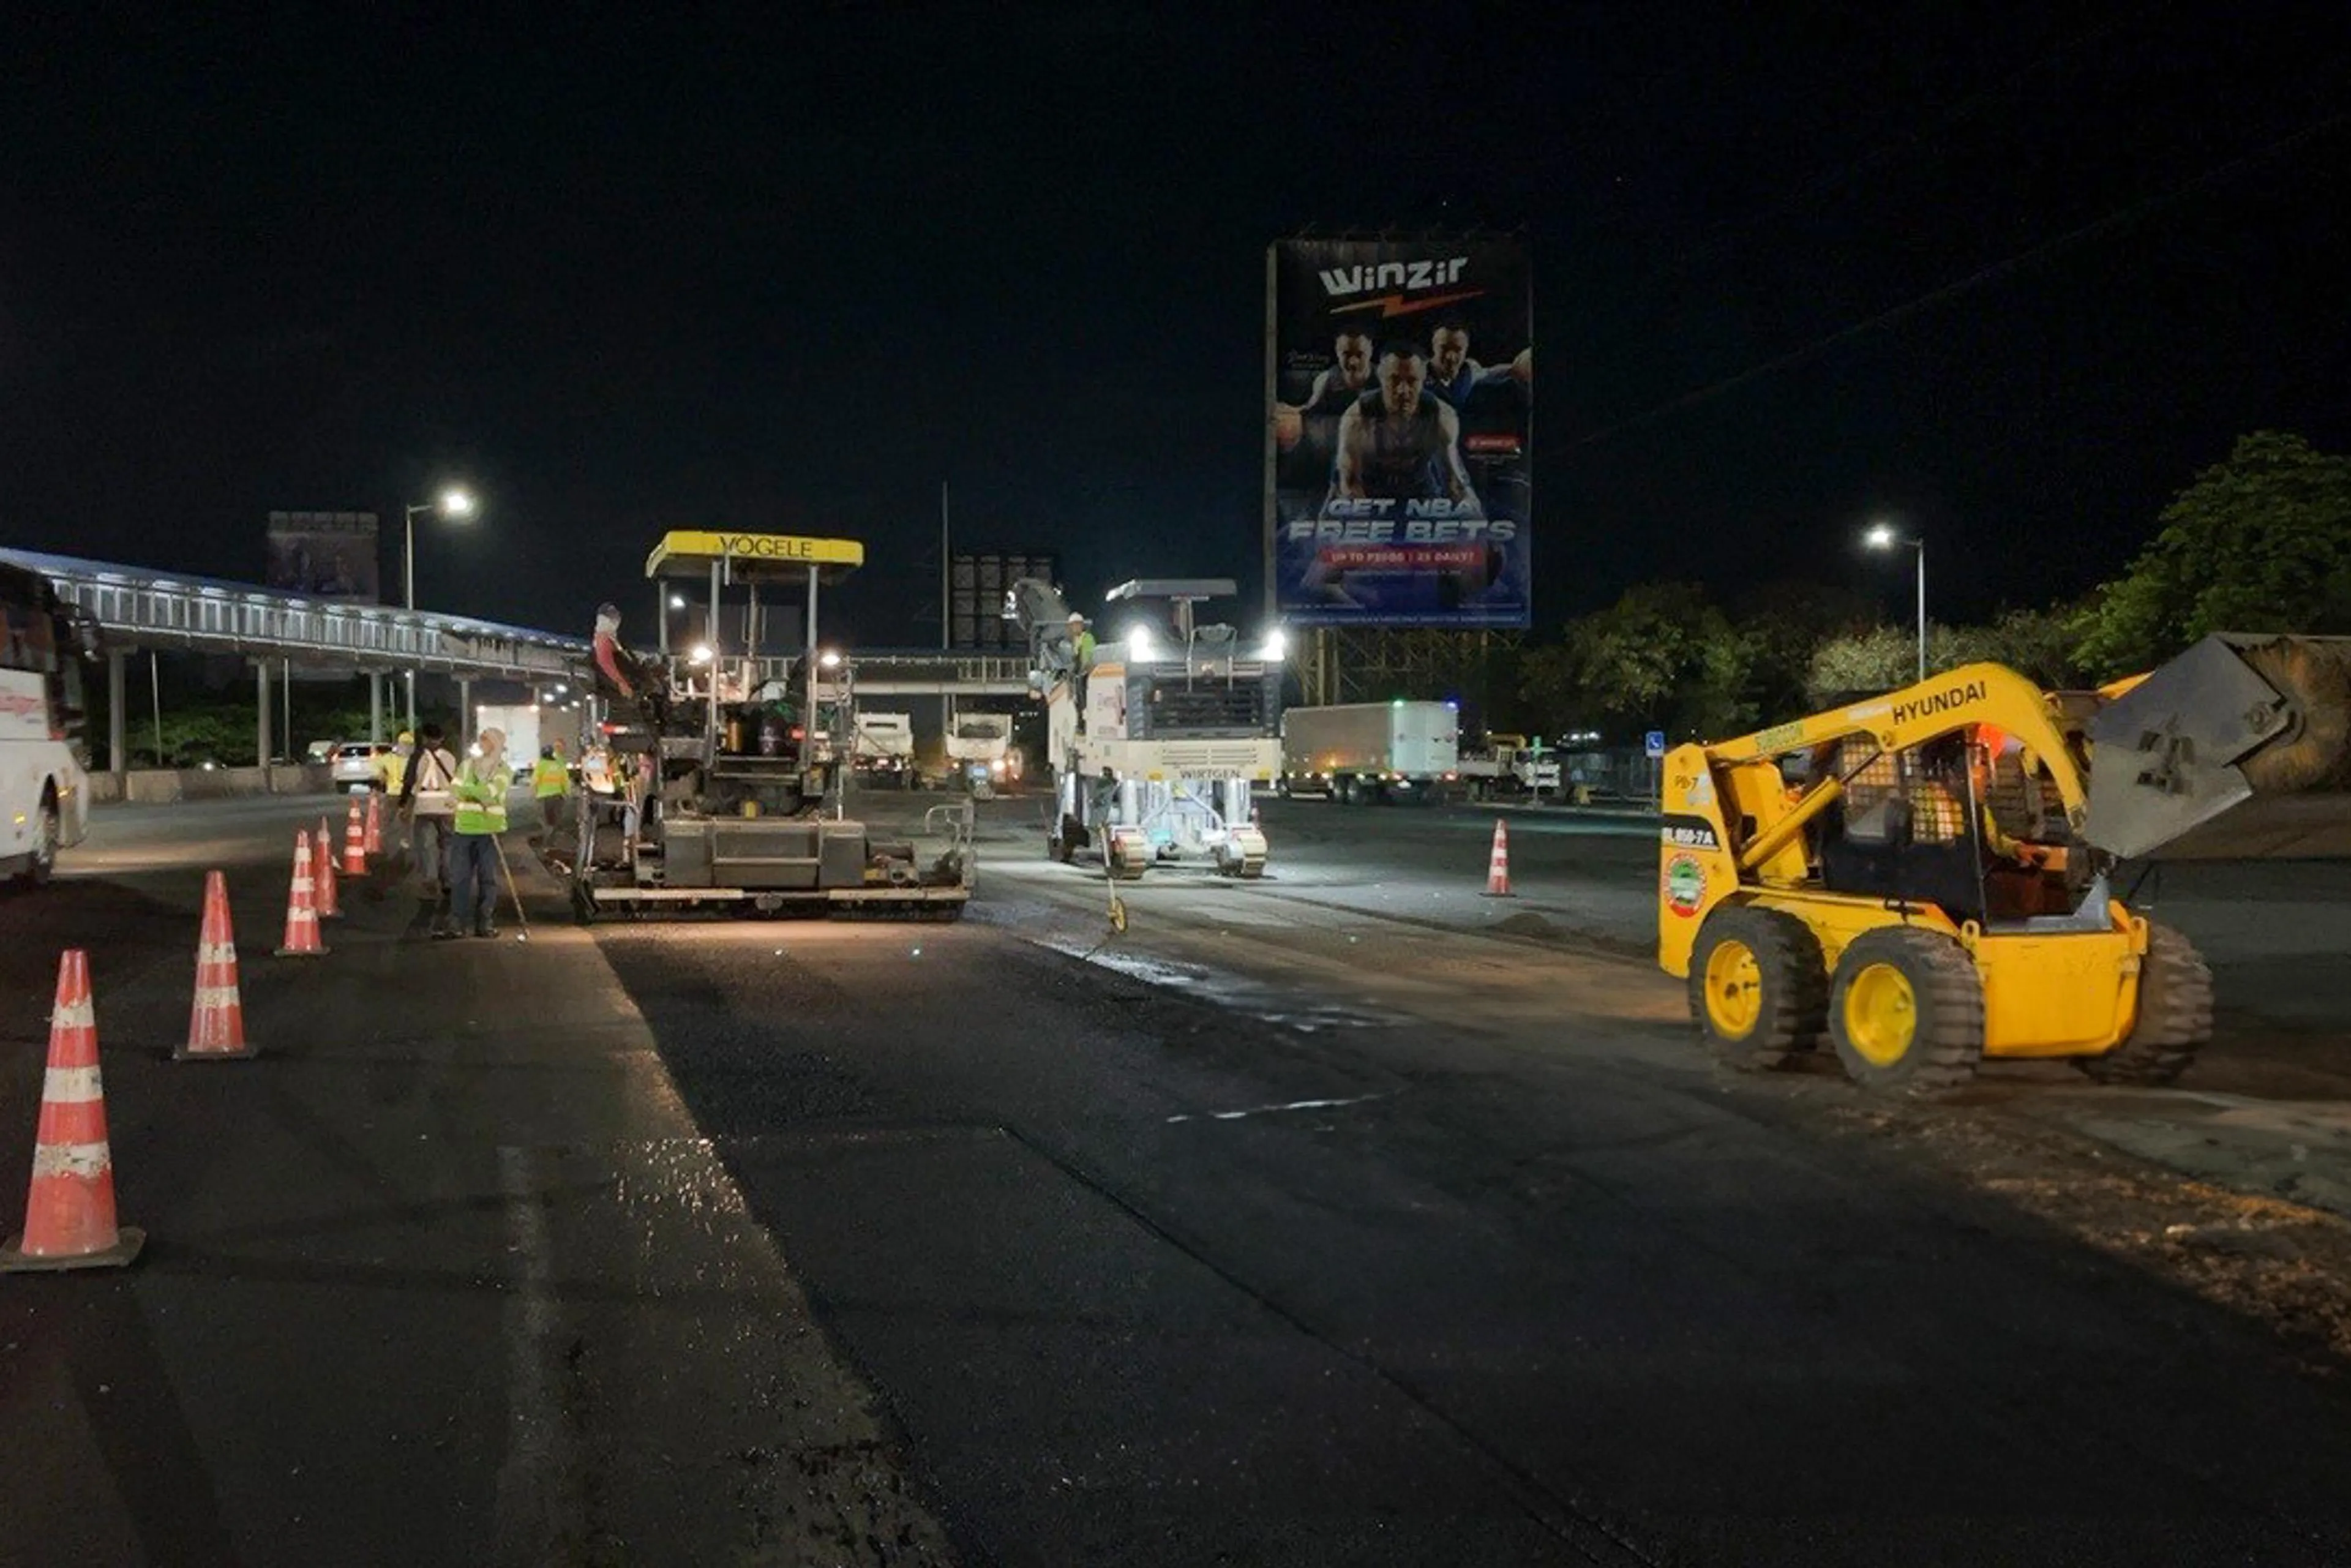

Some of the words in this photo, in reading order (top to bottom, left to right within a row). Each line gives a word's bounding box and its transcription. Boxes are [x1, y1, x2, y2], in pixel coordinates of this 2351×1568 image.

[1328, 498, 1397, 517] GET
[1405, 498, 1480, 518] NBA
[1288, 520, 1395, 542] FREE
[1405, 520, 1517, 542] BETS
[1893, 680, 1987, 726] HYUNDAI
